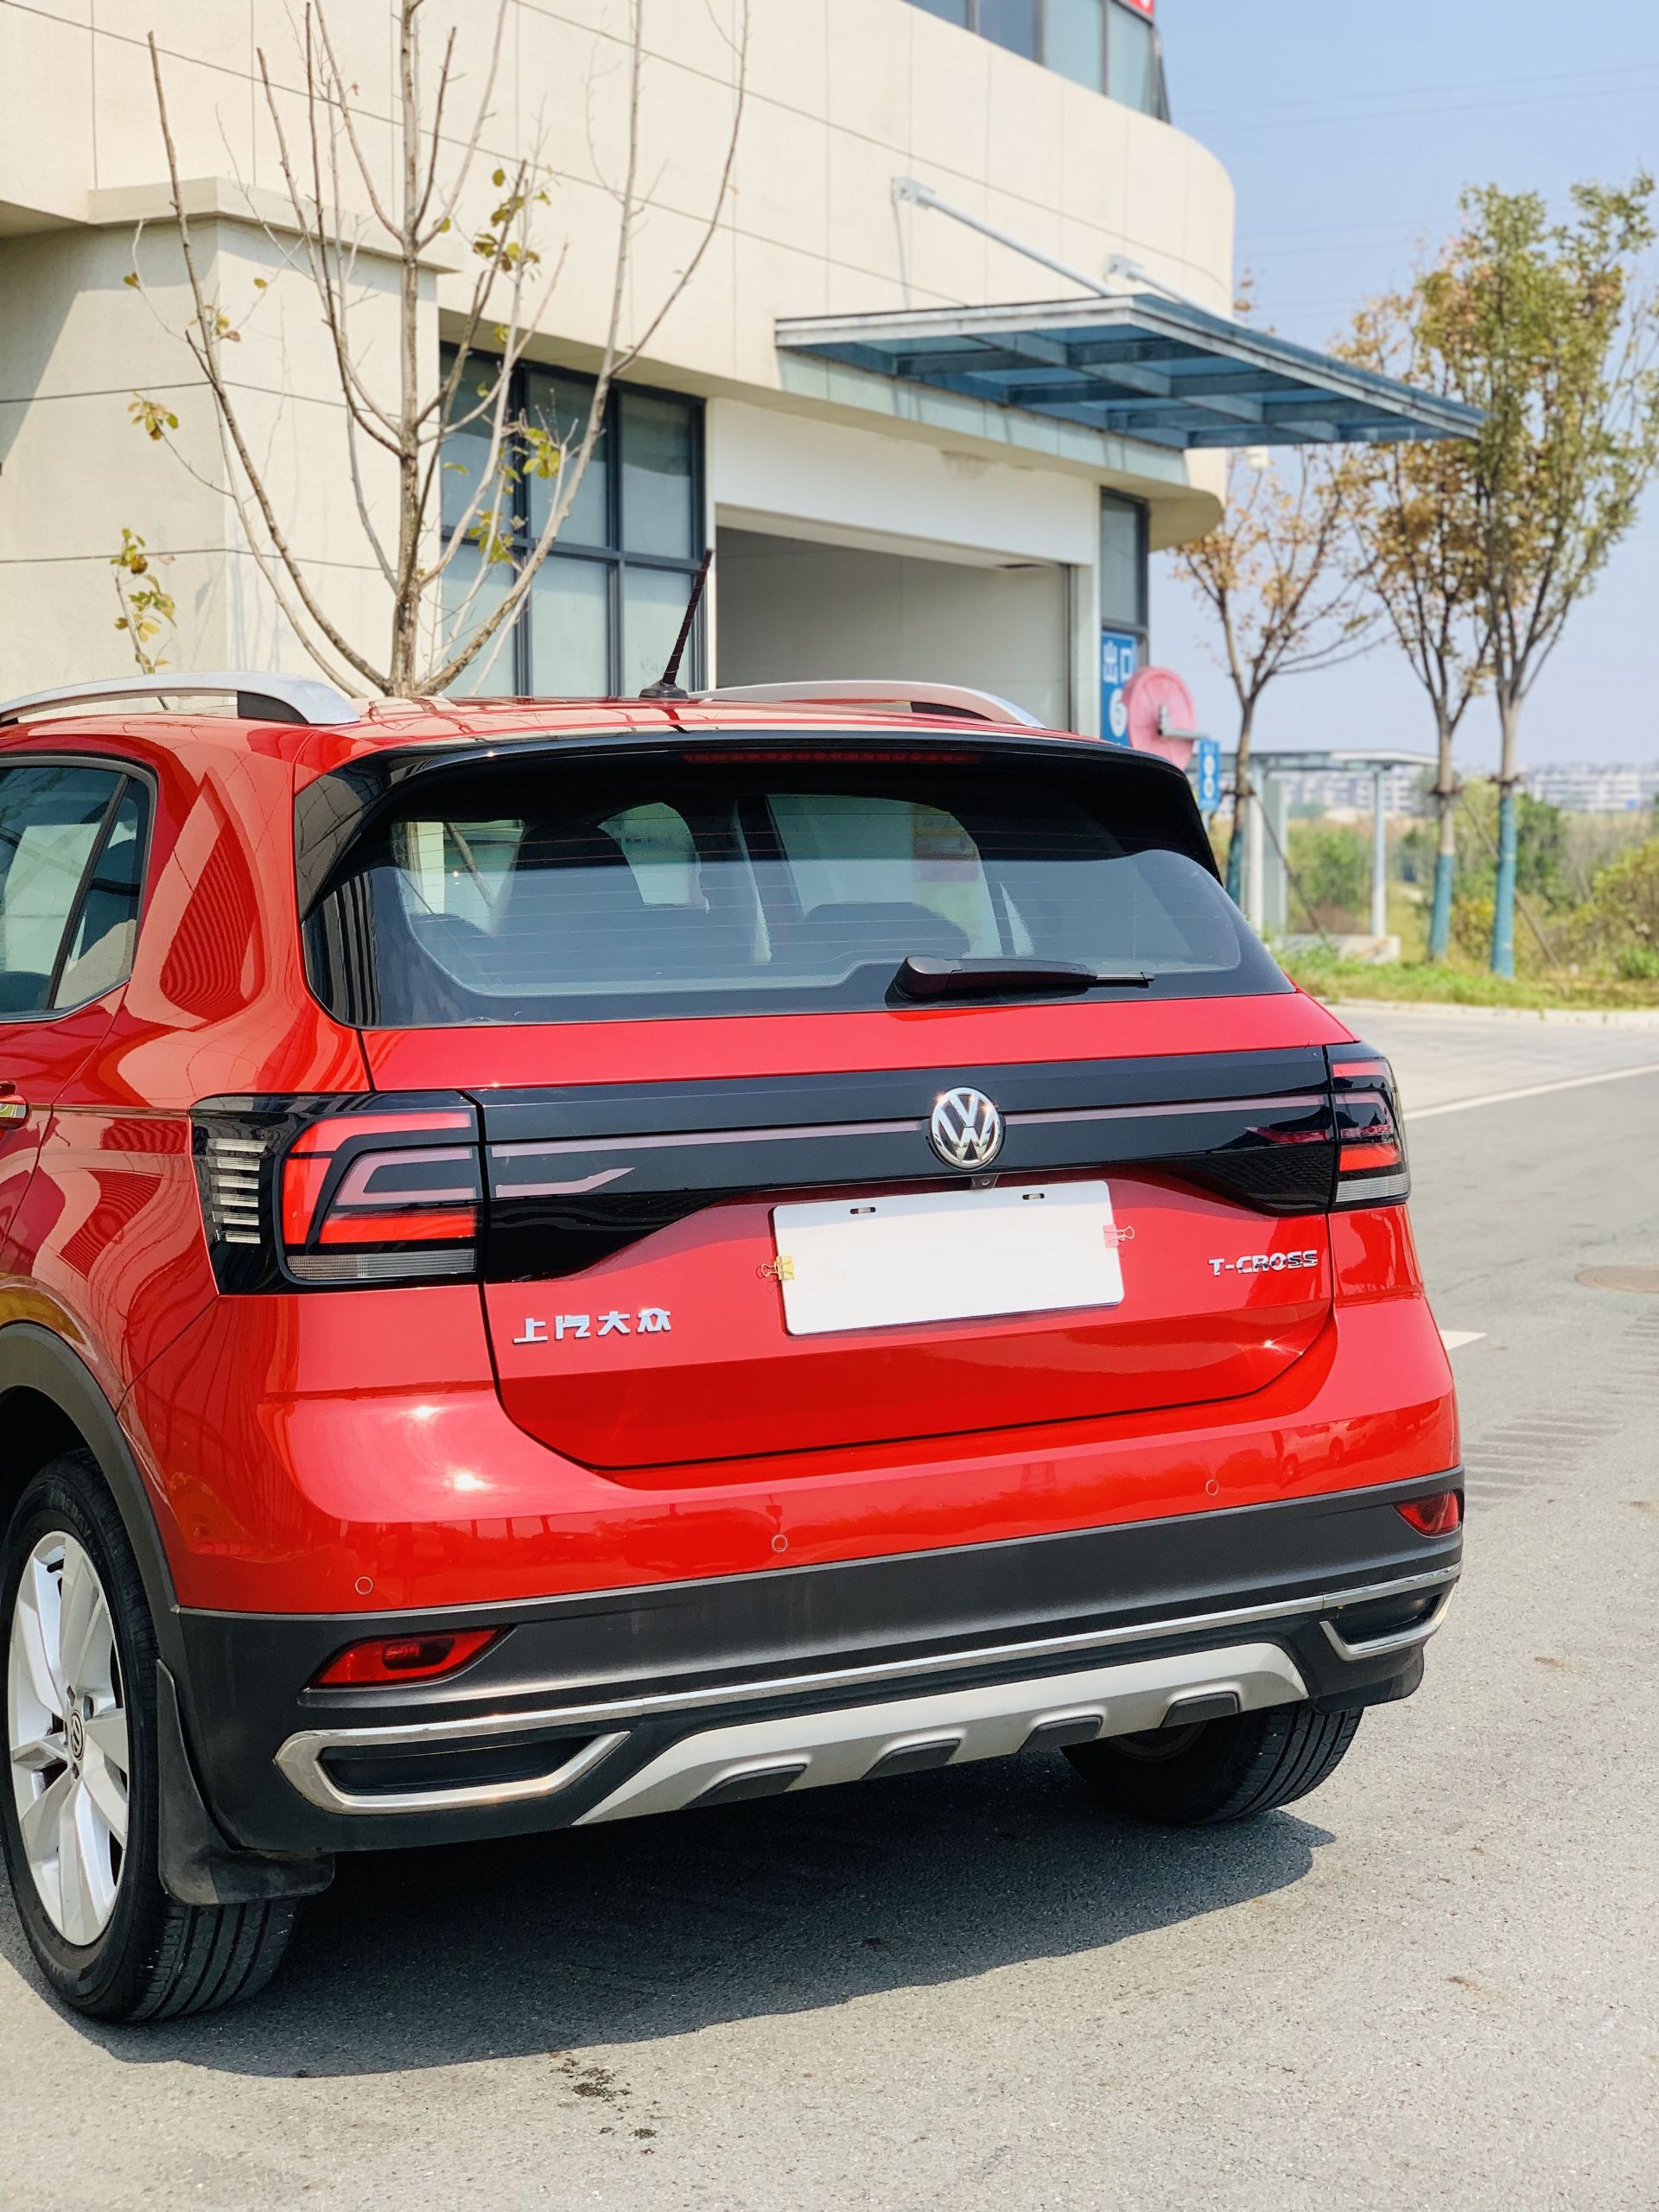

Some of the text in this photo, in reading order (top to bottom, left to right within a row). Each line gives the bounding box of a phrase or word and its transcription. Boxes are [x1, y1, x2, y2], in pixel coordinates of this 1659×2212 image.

[1208, 1249, 1319, 1276] T-CROSS
[513, 1307, 671, 1344] 上汽大众
